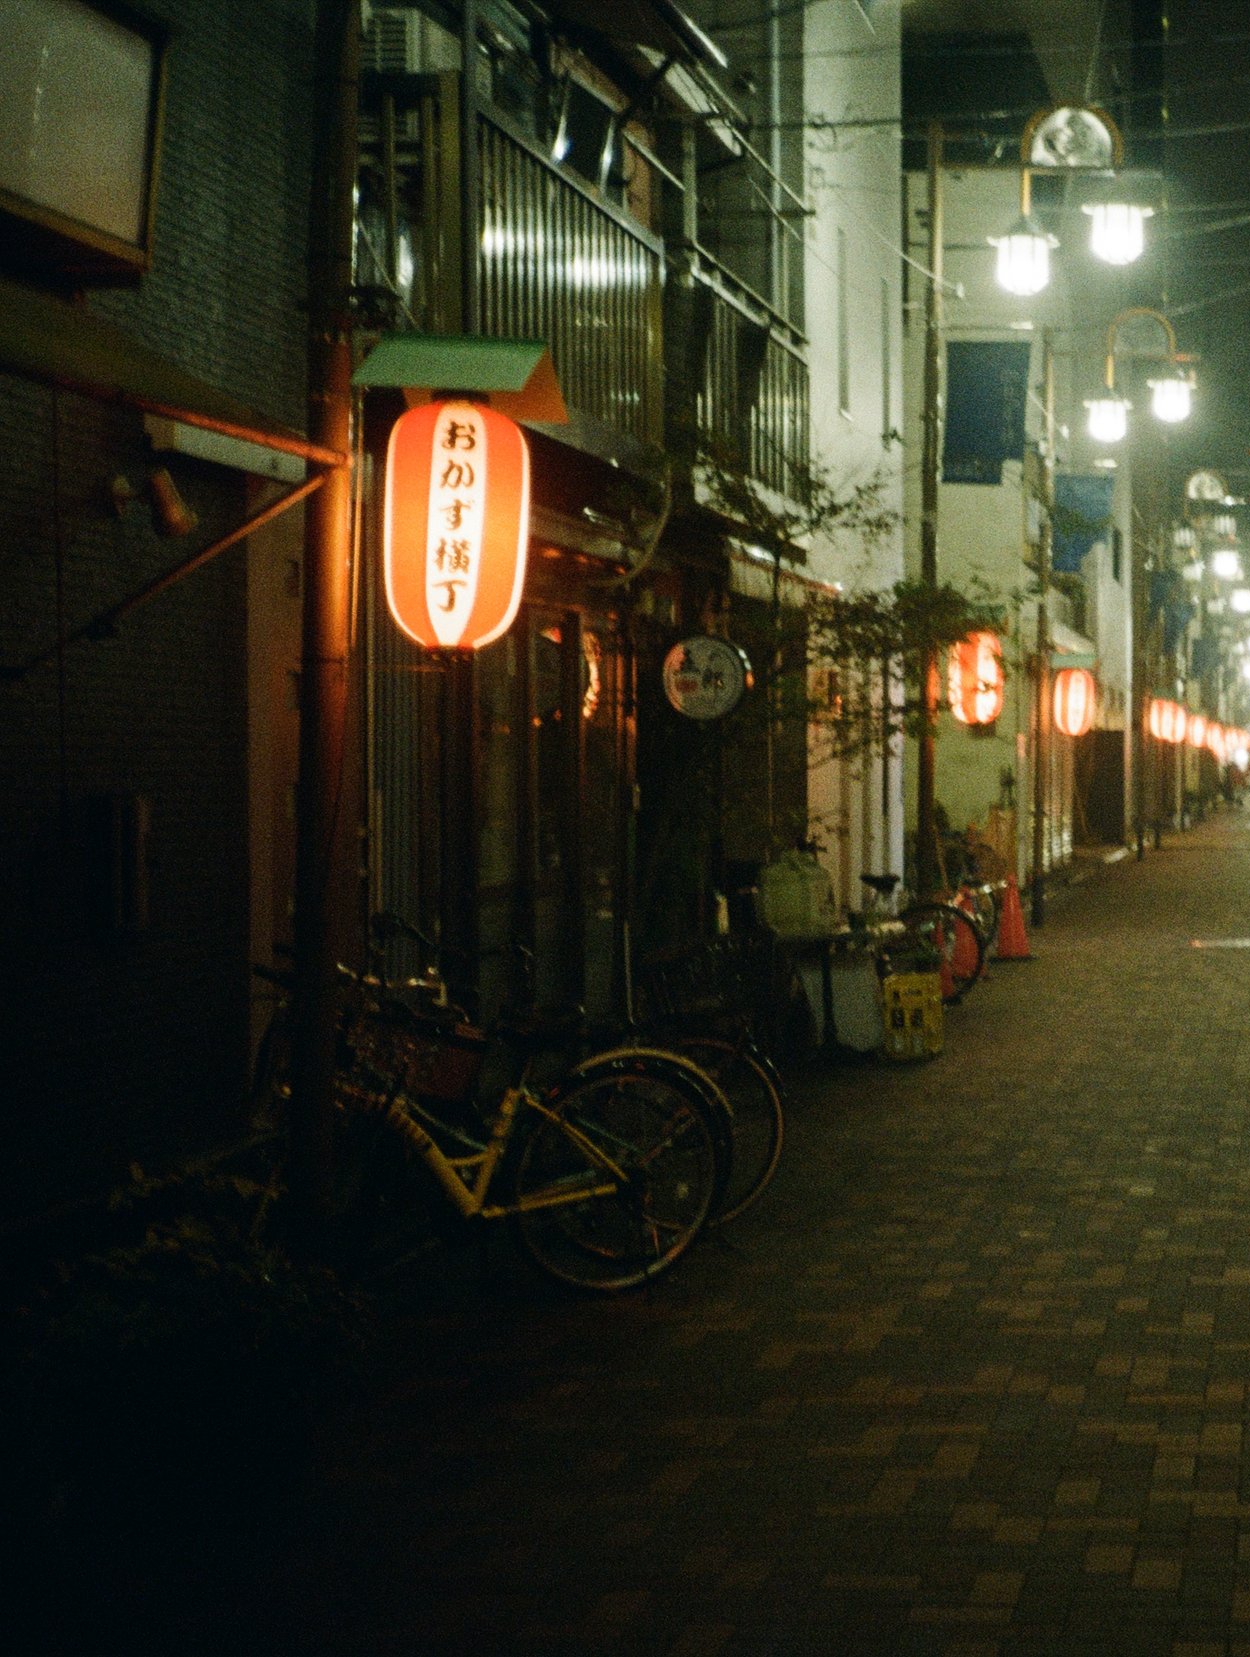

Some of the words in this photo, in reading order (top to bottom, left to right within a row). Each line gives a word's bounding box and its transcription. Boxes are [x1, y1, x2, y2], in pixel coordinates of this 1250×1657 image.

[432, 420, 476, 613] おかず横丁
